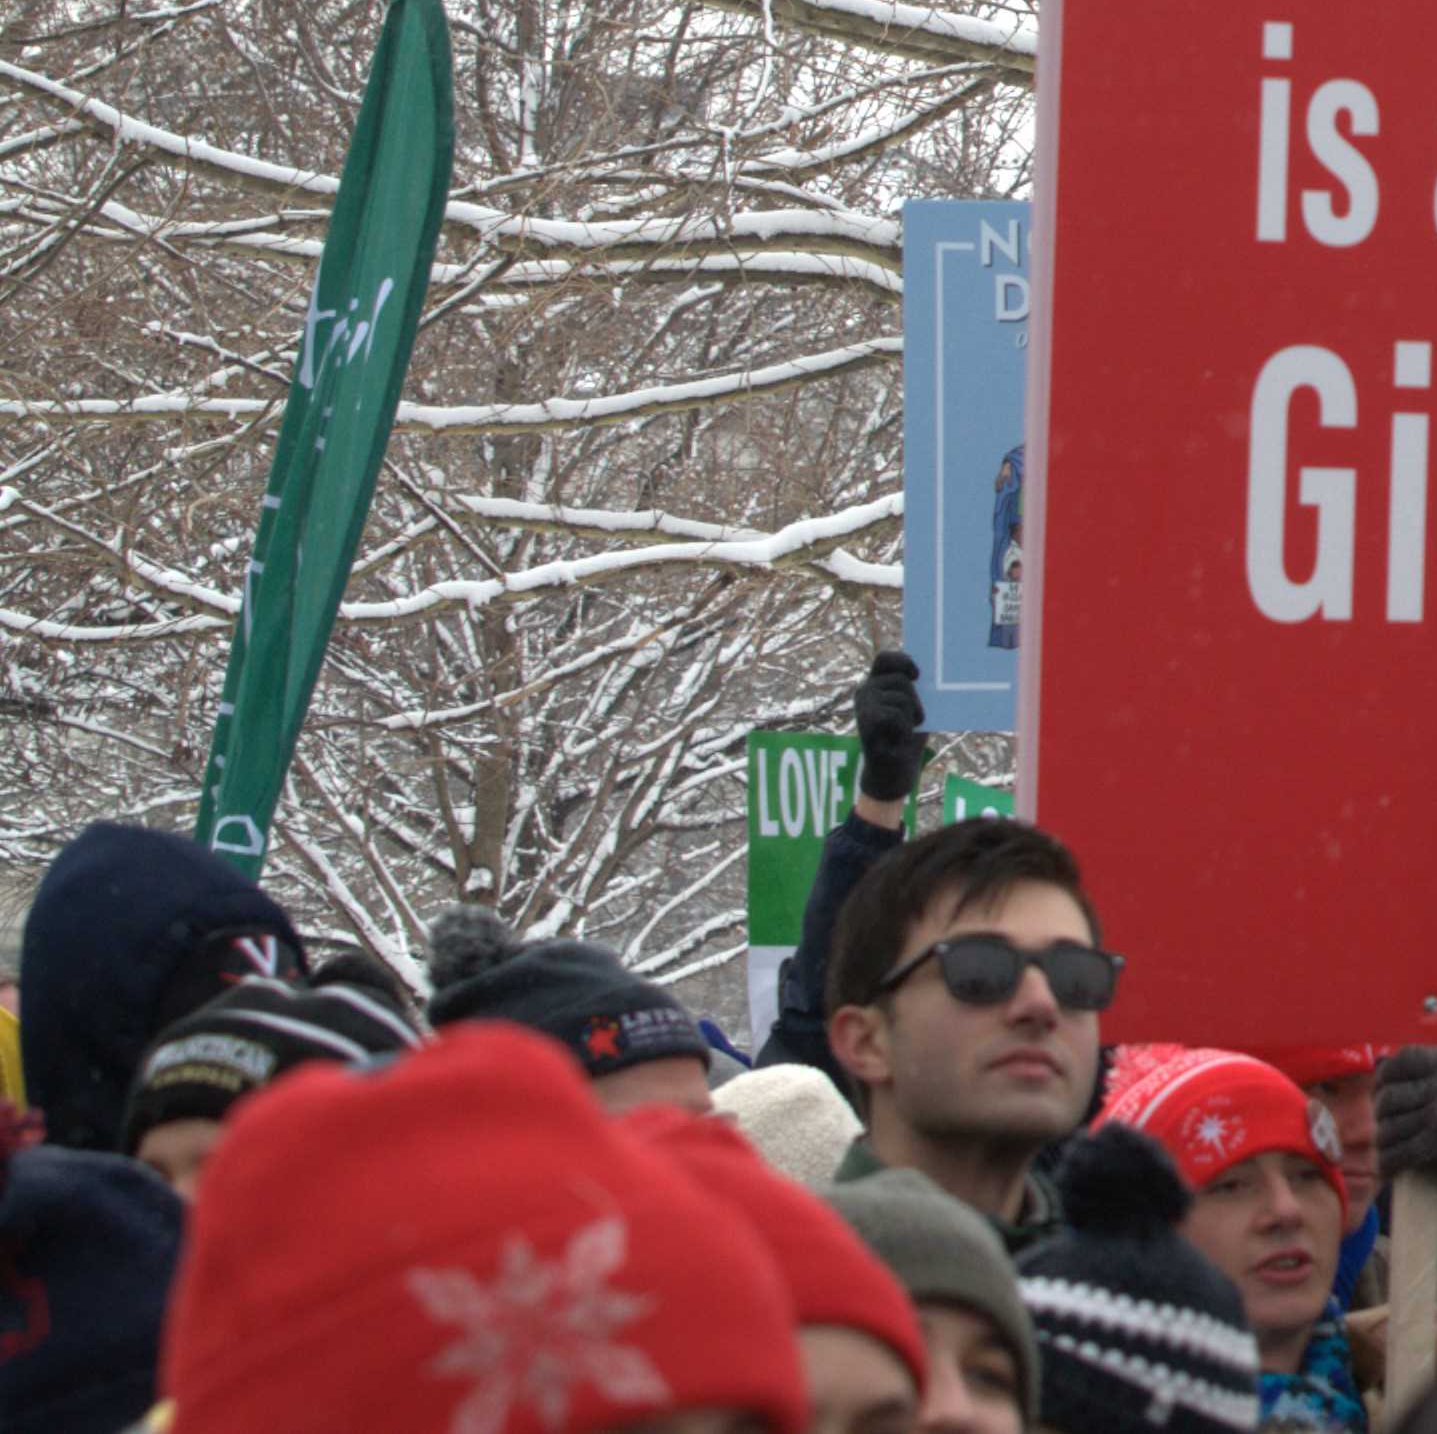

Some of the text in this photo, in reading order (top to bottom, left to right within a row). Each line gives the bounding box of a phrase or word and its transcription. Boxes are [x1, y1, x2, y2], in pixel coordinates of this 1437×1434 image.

[1256, 21, 1381, 248] is
[980, 218, 1031, 267] N
[757, 746, 848, 838] LOVE
